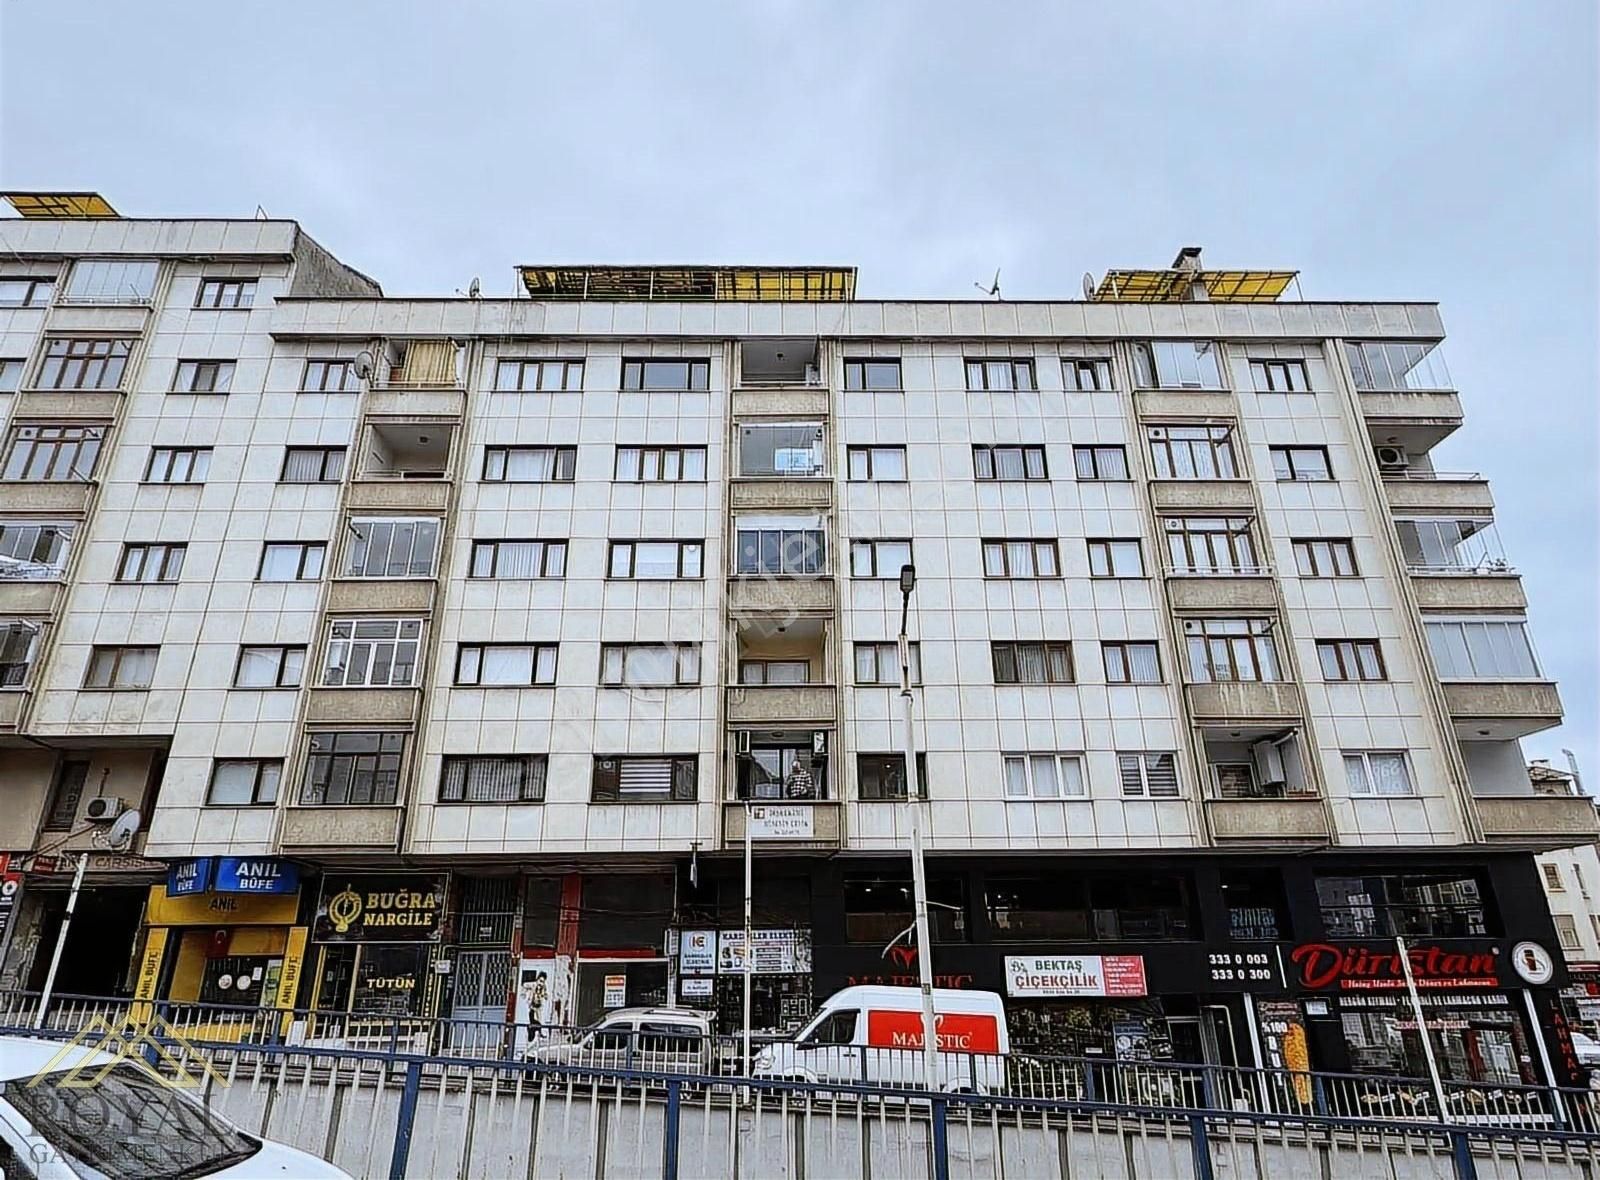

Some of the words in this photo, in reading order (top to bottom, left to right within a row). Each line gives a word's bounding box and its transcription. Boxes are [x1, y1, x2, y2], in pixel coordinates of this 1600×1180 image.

[176, 863, 197, 879] ANIL
[235, 862, 281, 877] ANIL
[239, 877, 274, 889] BÜFE
[365, 888, 436, 909] BUĞRA
[362, 909, 433, 926] NARGİLE
[1035, 960, 1082, 972] BEKTAŞ
[1208, 954, 1231, 964] 333
[1235, 954, 1243, 964] 0
[1246, 954, 1268, 964] 003
[1015, 972, 1098, 989] ÇİÇEKÇİLİK
[1211, 969, 1234, 980] 333
[1237, 969, 1245, 980] 0
[1249, 969, 1271, 980] 300
[366, 976, 416, 989] TÜTÜN
[892, 1032, 971, 1049] MAJSTIC
